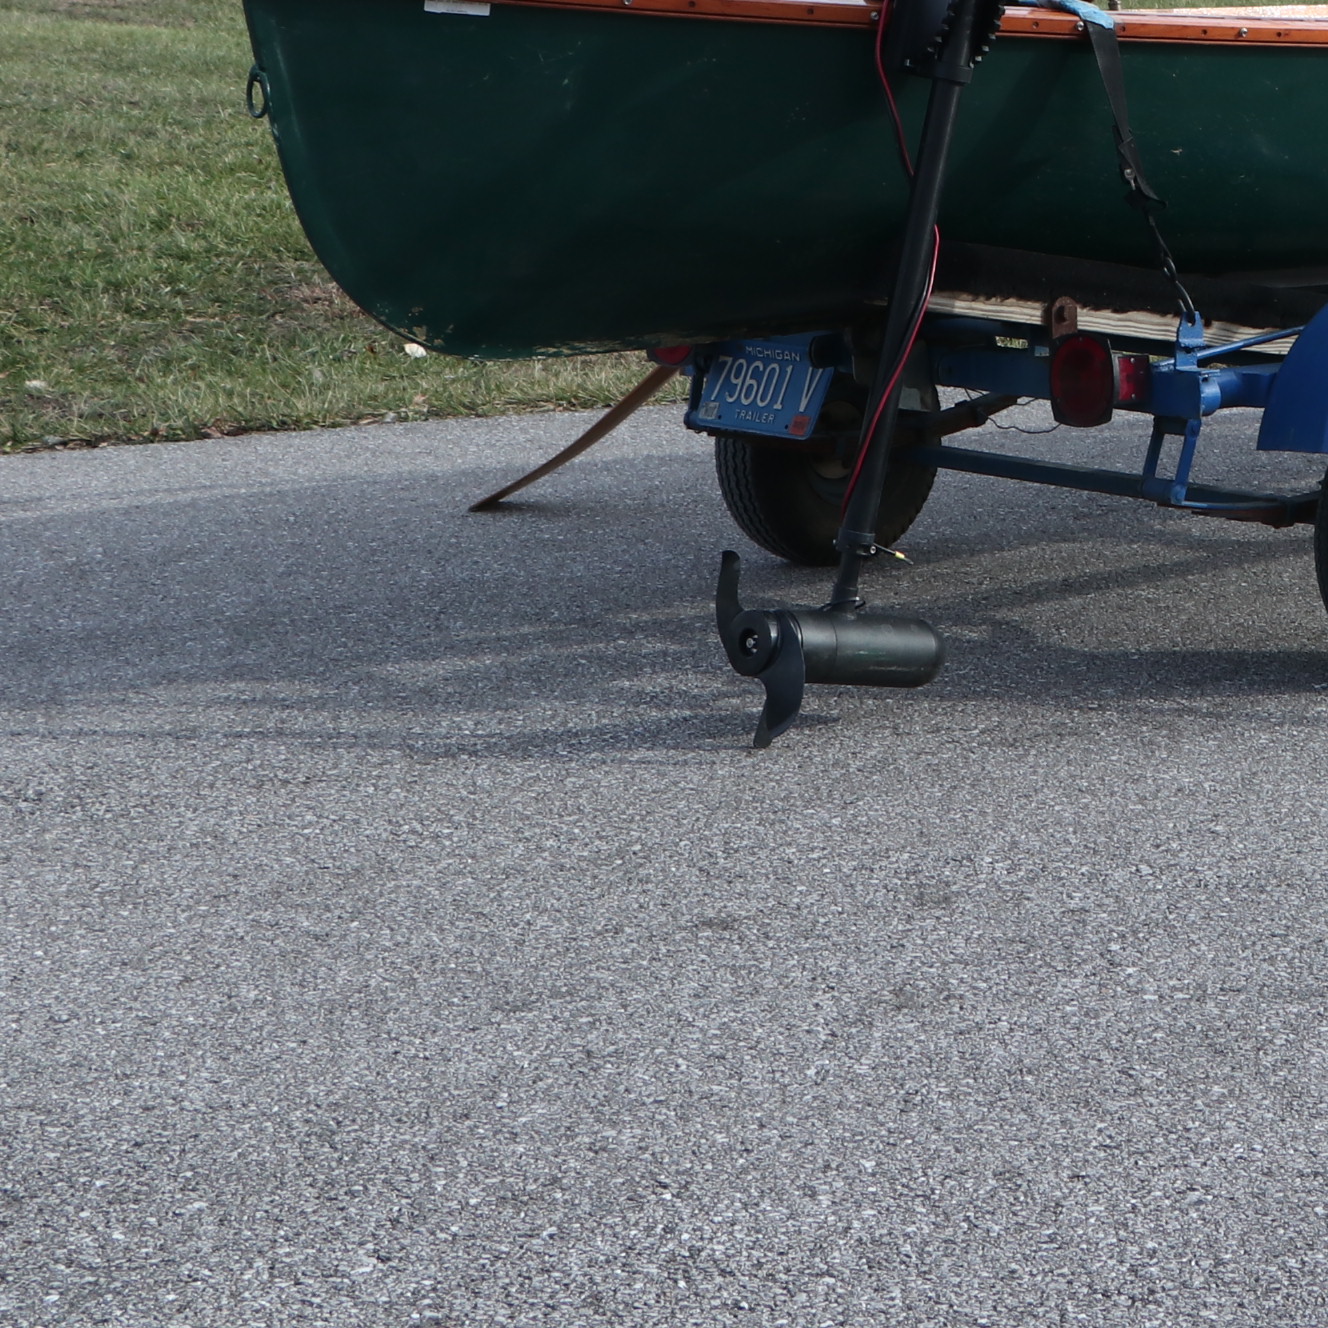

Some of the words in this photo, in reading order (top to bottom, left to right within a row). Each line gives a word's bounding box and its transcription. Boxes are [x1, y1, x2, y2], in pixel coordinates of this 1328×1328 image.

[745, 346, 800, 362] MICHIGAN
[710, 355, 793, 410] 79601
[799, 366, 824, 413] V
[735, 409, 775, 424] TRAILER
